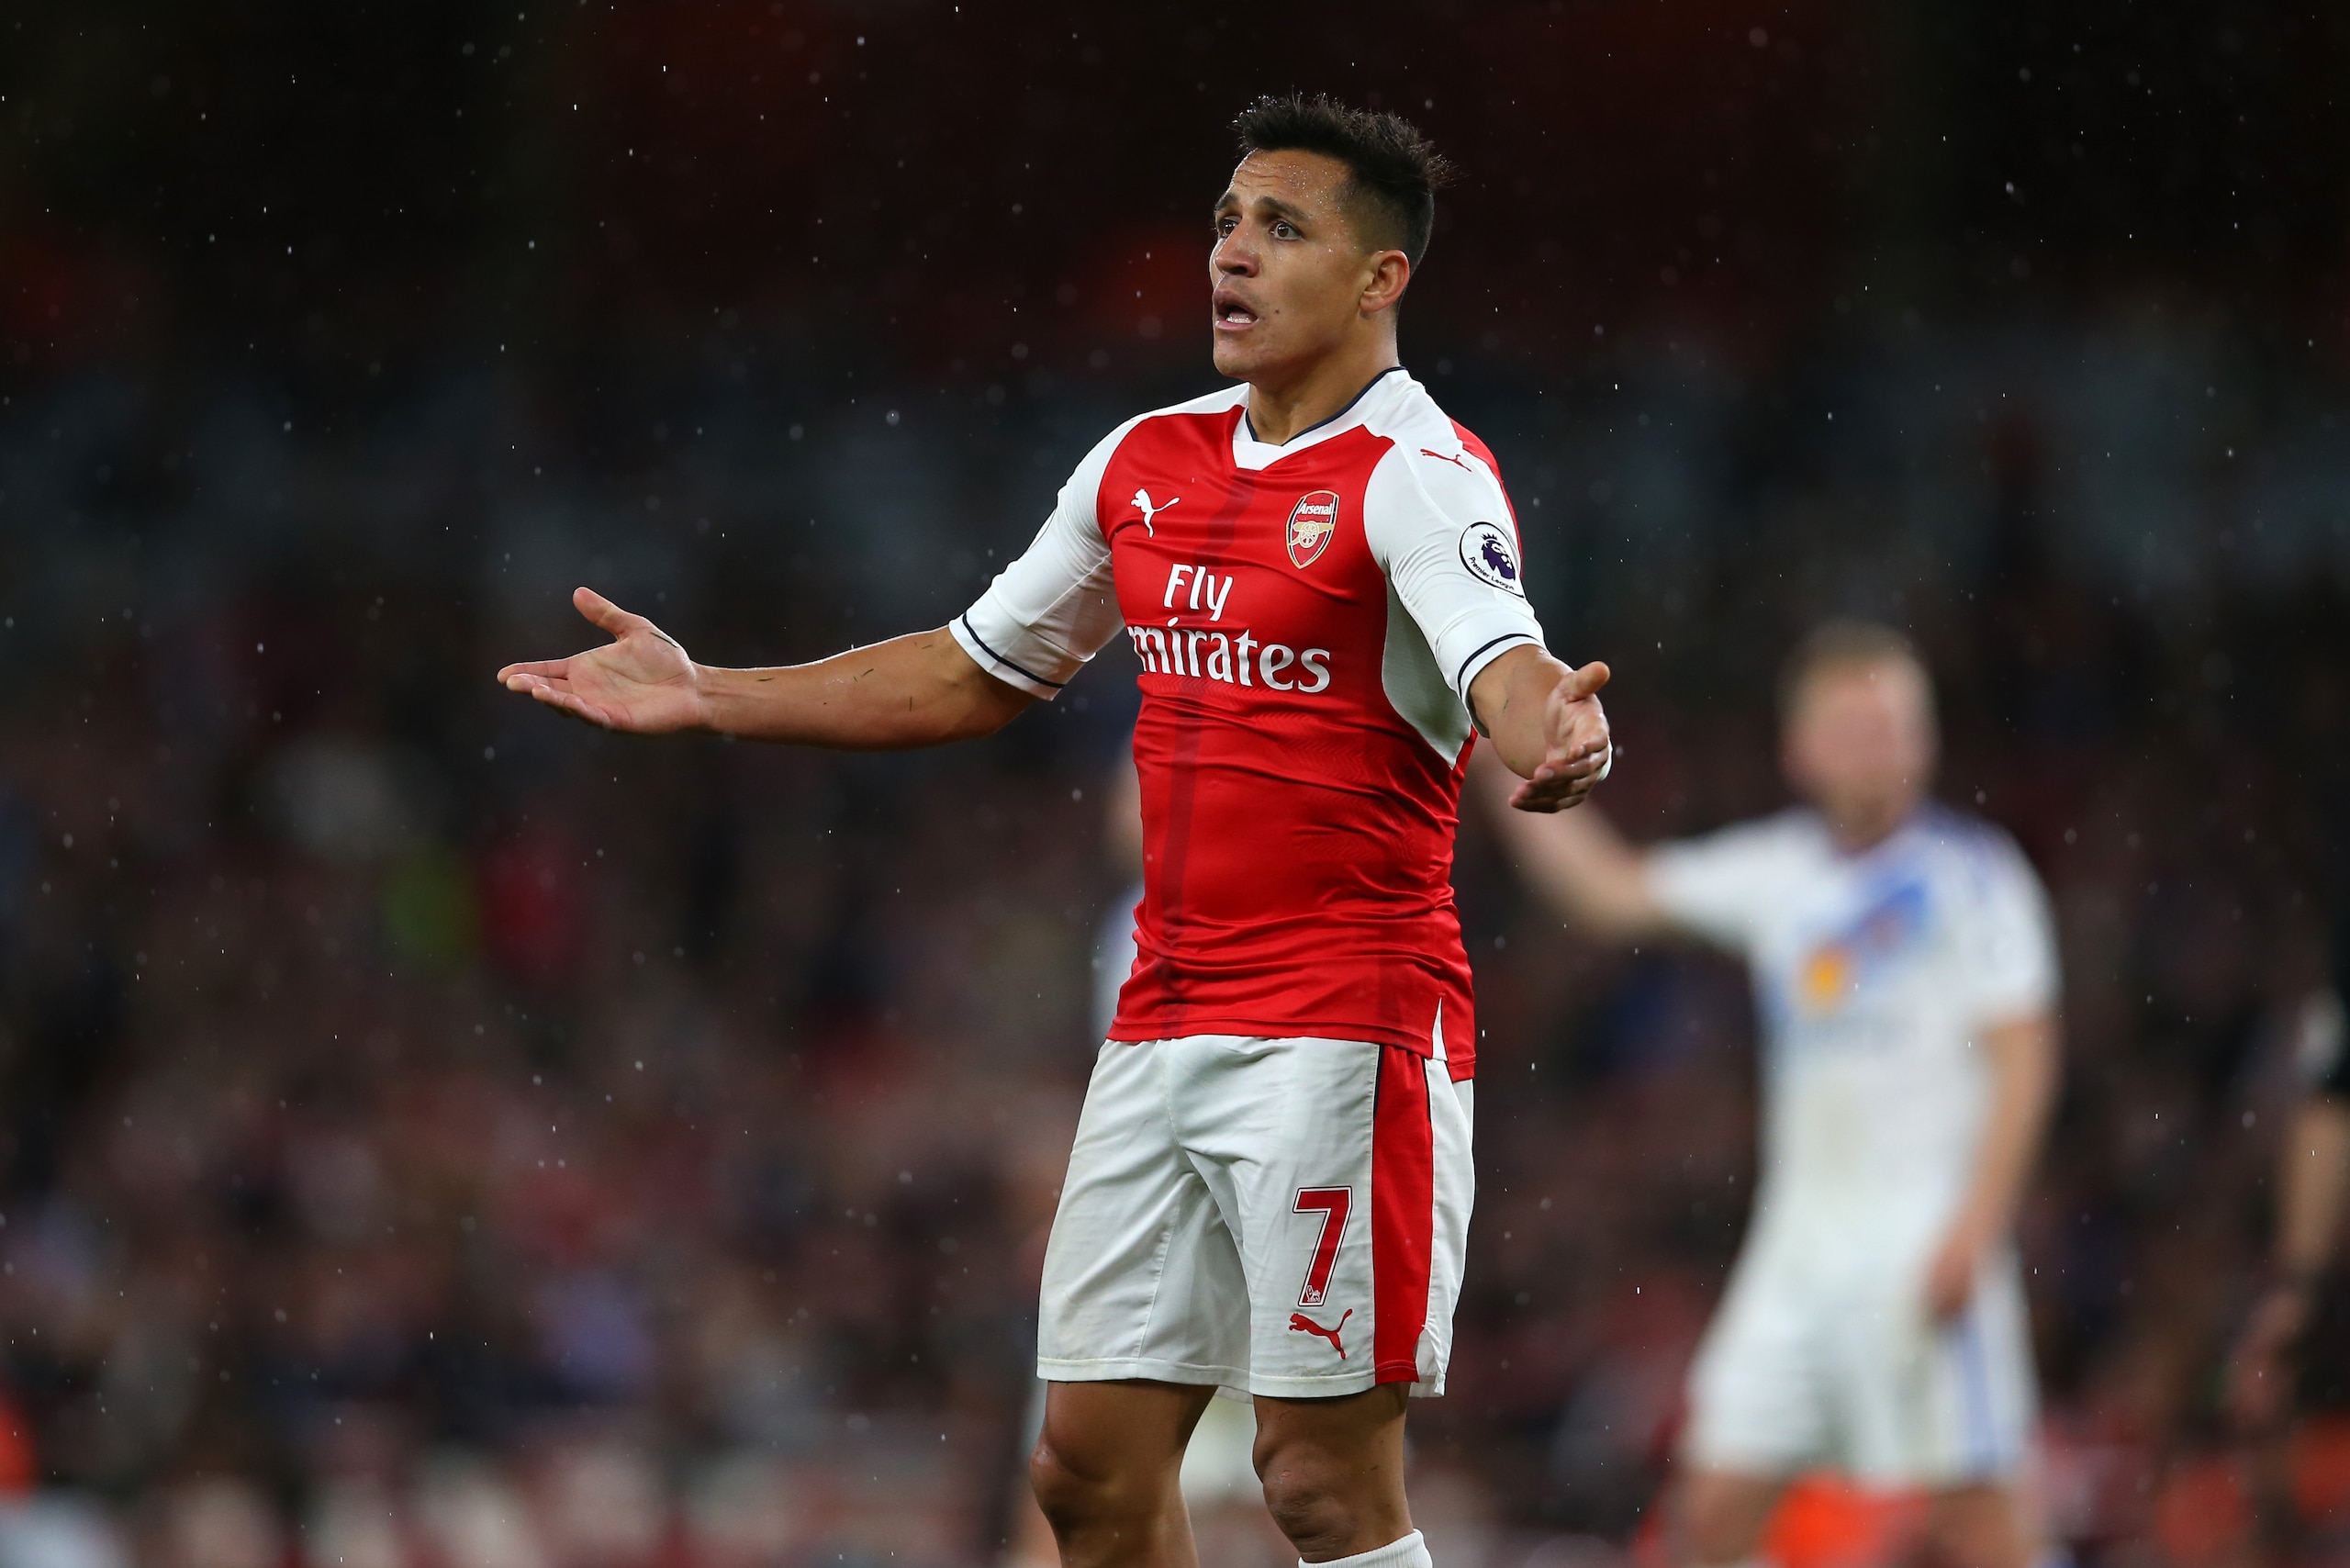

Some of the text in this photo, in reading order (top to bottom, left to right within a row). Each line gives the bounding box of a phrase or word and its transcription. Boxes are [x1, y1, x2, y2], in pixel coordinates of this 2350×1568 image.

[1298, 503, 1333, 515] Arsenal
[1163, 563, 1233, 622] Fly
[1469, 556, 1490, 577] Premier
[1127, 617, 1331, 693] mirates
[1292, 1186, 1353, 1306] 7
